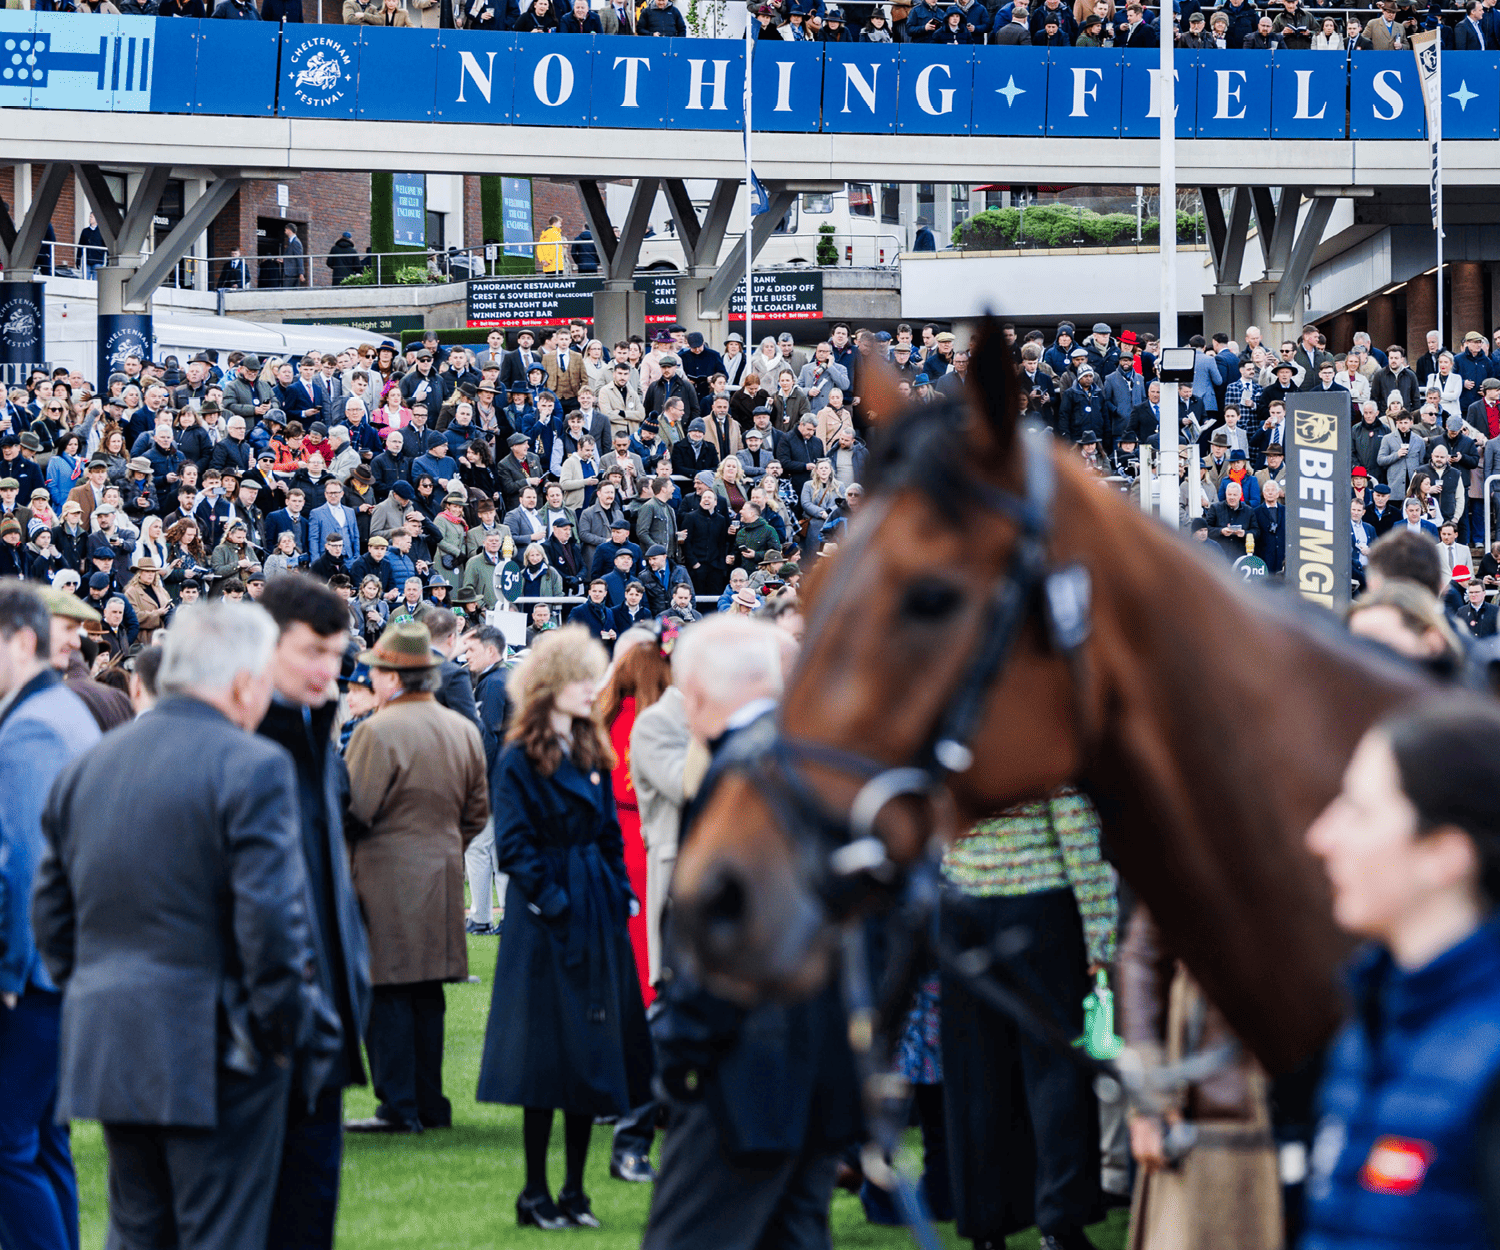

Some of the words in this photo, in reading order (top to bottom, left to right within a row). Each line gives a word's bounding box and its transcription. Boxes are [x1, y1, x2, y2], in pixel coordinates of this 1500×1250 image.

[290, 37, 351, 65] CHELTENHAM
[456, 52, 957, 116] NOTHING
[1069, 67, 1405, 121] FEELS
[294, 89, 345, 107] FESTIVAL
[753, 276, 777, 284] RANK
[472, 283, 523, 291] PANORAMIC
[523, 281, 576, 290] RESTAURANT
[754, 285, 765, 293] UP
[766, 285, 773, 293] &
[774, 284, 798, 293] DROP
[799, 284, 815, 292] OFF
[472, 293, 499, 301] CREST
[499, 292, 506, 300] &
[506, 291, 554, 300] SOVEREIGN
[771, 294, 797, 302] BUSES
[0, 298, 42, 319] CHELTENHAM
[472, 302, 497, 310] HOME
[498, 301, 541, 309] STRAIGHT
[541, 300, 559, 308] BAR
[764, 303, 794, 312] COACH
[795, 303, 817, 311] PARK
[472, 311, 512, 319] WINNING
[513, 310, 535, 319] POST
[535, 310, 553, 318] BAR
[351, 321, 378, 331] Height
[379, 320, 392, 329] 3M
[3, 336, 39, 348] FESTIVAL
[106, 328, 150, 350] CHELTENHAM
[1240, 564, 1265, 582] 2nd
[503, 570, 520, 591] 3rd
